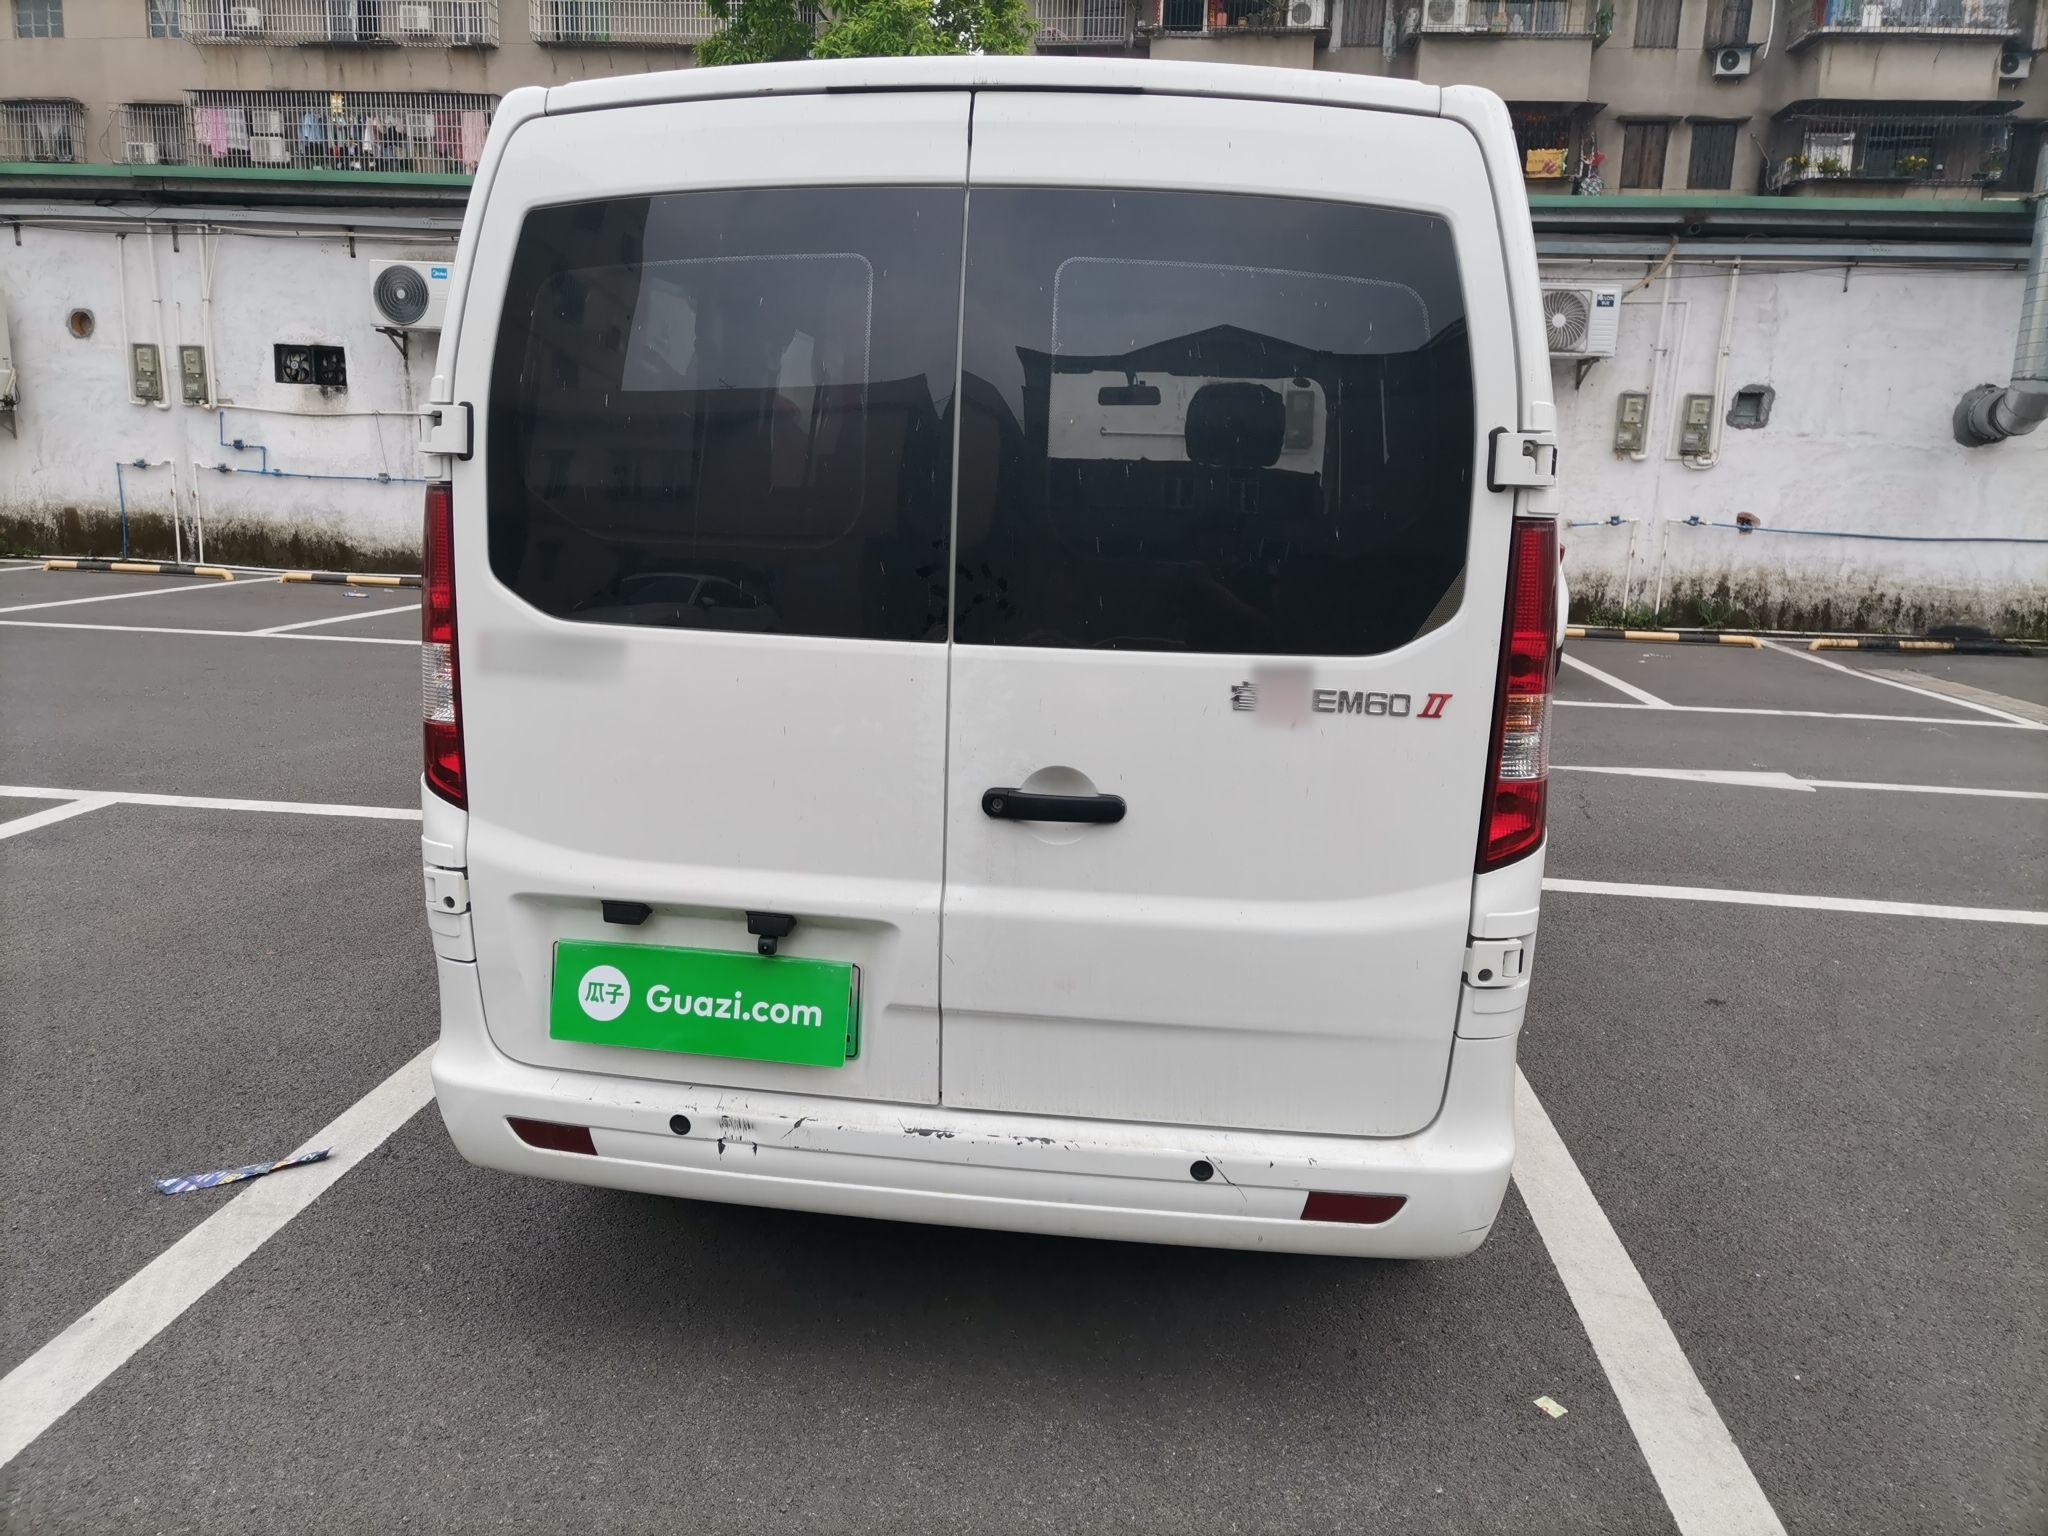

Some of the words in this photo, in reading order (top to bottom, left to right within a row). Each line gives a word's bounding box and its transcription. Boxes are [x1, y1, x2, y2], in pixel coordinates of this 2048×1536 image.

[1312, 688, 1412, 717] EM60
[585, 982, 624, 1005] 瓜子
[646, 984, 822, 1027] Guazi.com
